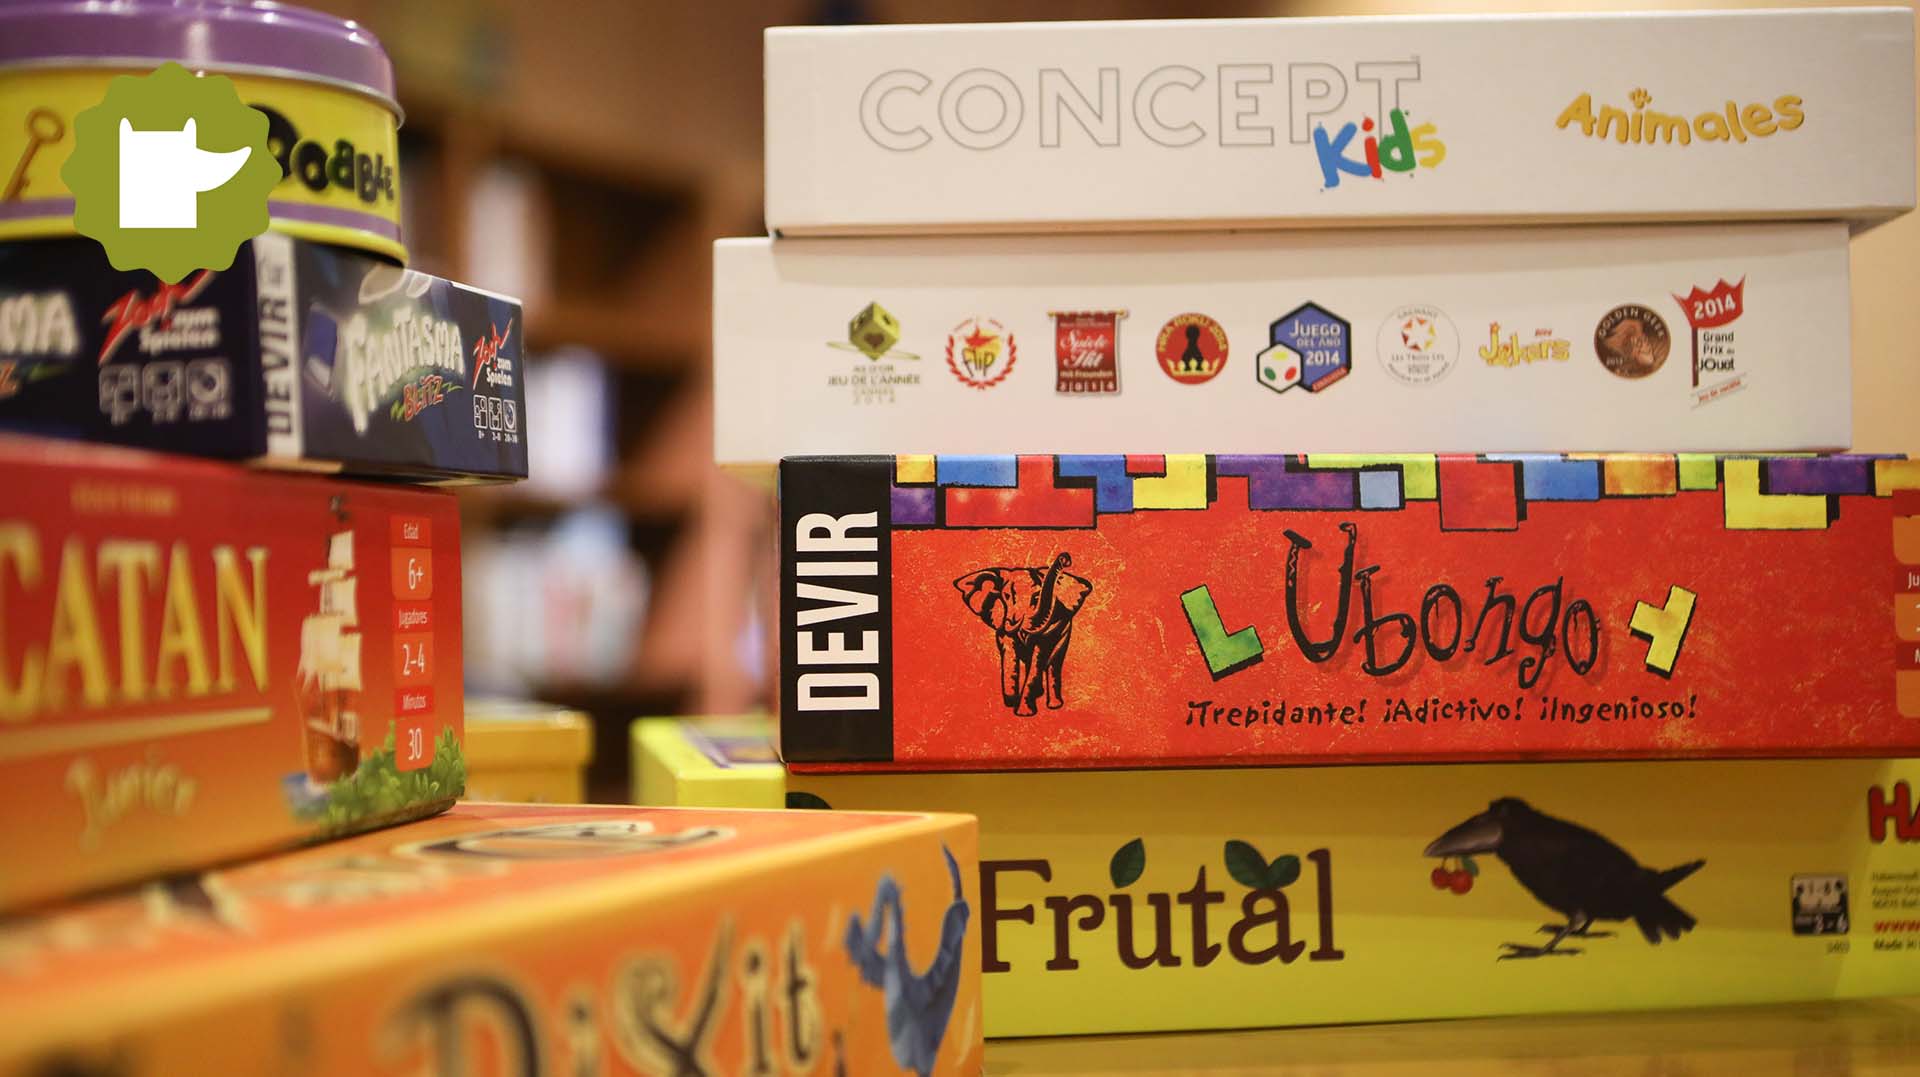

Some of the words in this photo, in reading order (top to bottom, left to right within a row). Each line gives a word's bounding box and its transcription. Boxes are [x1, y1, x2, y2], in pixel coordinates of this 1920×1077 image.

[860, 62, 1421, 152] CONCEPT
[1555, 87, 1805, 146] Animales
[1312, 108, 1447, 190] Kids
[1289, 319, 1341, 337] JUEGO
[1694, 294, 1736, 320] 2014
[259, 296, 293, 435] DEVIR
[1306, 350, 1340, 367] 2014
[1703, 332, 1734, 343] Grand
[346, 305, 466, 433] FANTASMA
[408, 558, 424, 590] 6+
[0, 517, 271, 722] CATAN
[795, 511, 880, 711] DEVIR
[1283, 521, 1600, 690] Ubongo
[403, 644, 425, 676] 2-4
[1186, 698, 1366, 728] ¡Trepidante!
[1383, 697, 1524, 722] ¡Adictivo!
[1540, 696, 1697, 723] ¡Ingenioso!
[408, 728, 423, 761] 30
[979, 848, 1345, 973] Frutal
